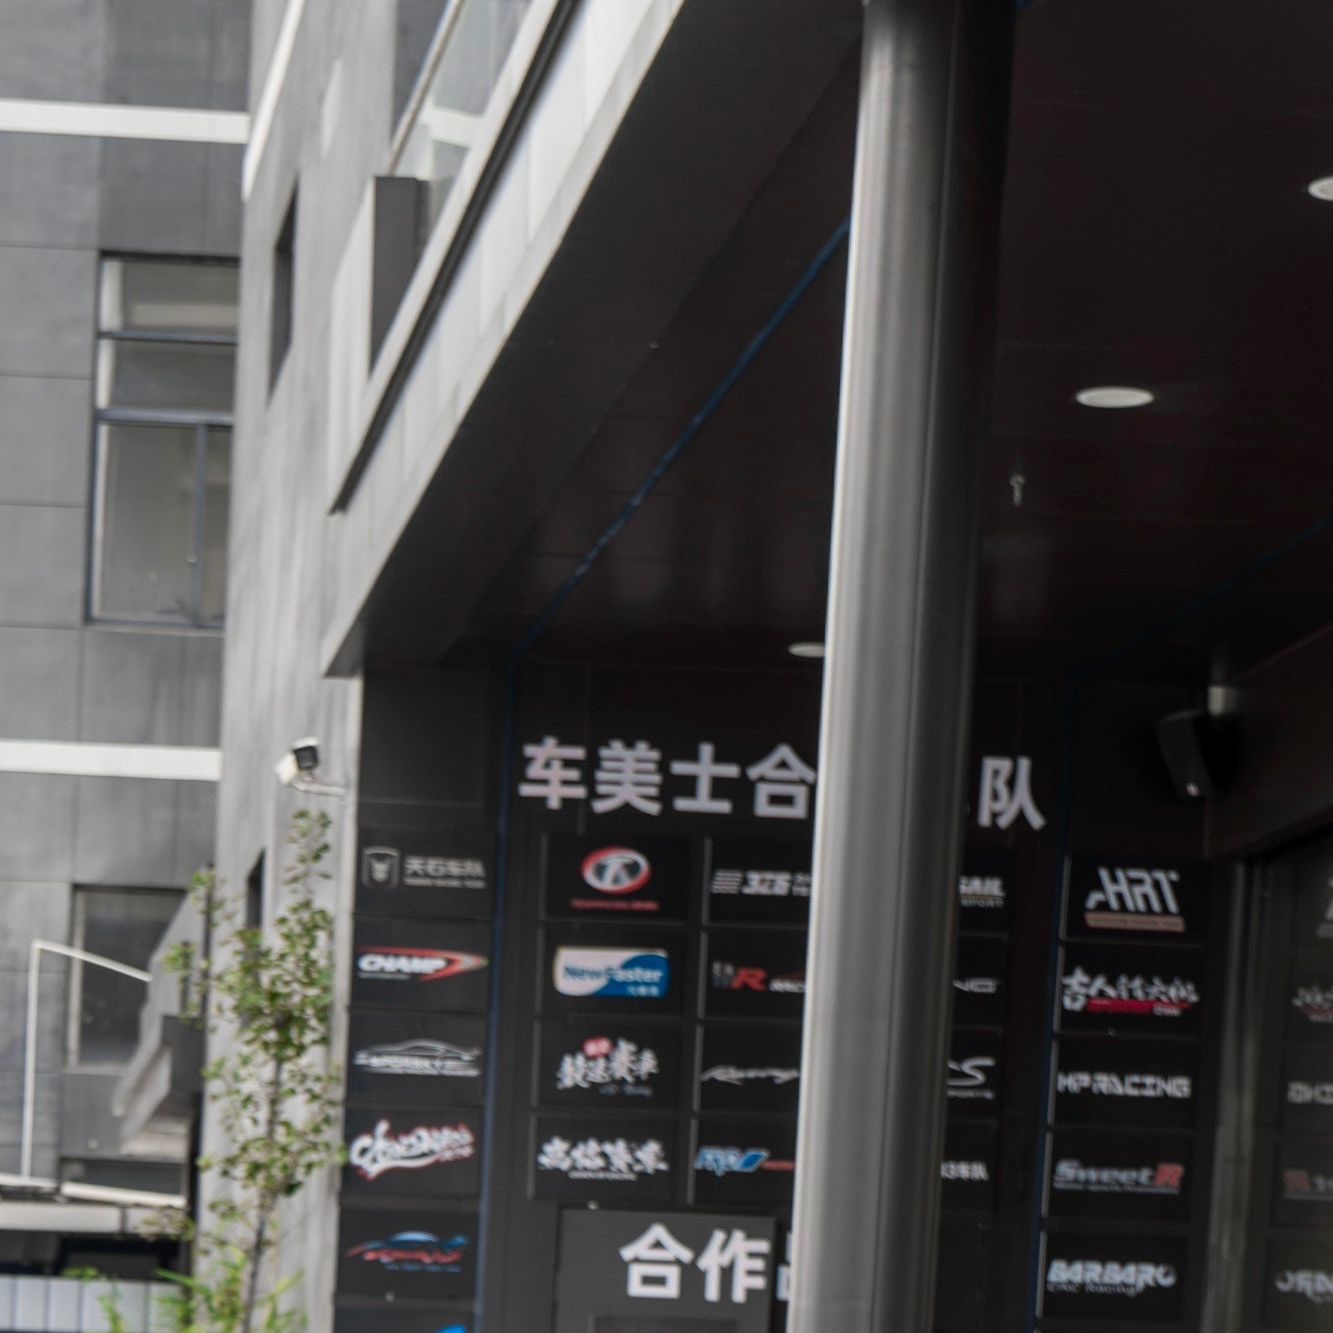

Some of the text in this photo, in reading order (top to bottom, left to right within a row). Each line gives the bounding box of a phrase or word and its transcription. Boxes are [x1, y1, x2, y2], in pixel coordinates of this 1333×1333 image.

[518, 736, 1047, 831] 车美士合队
